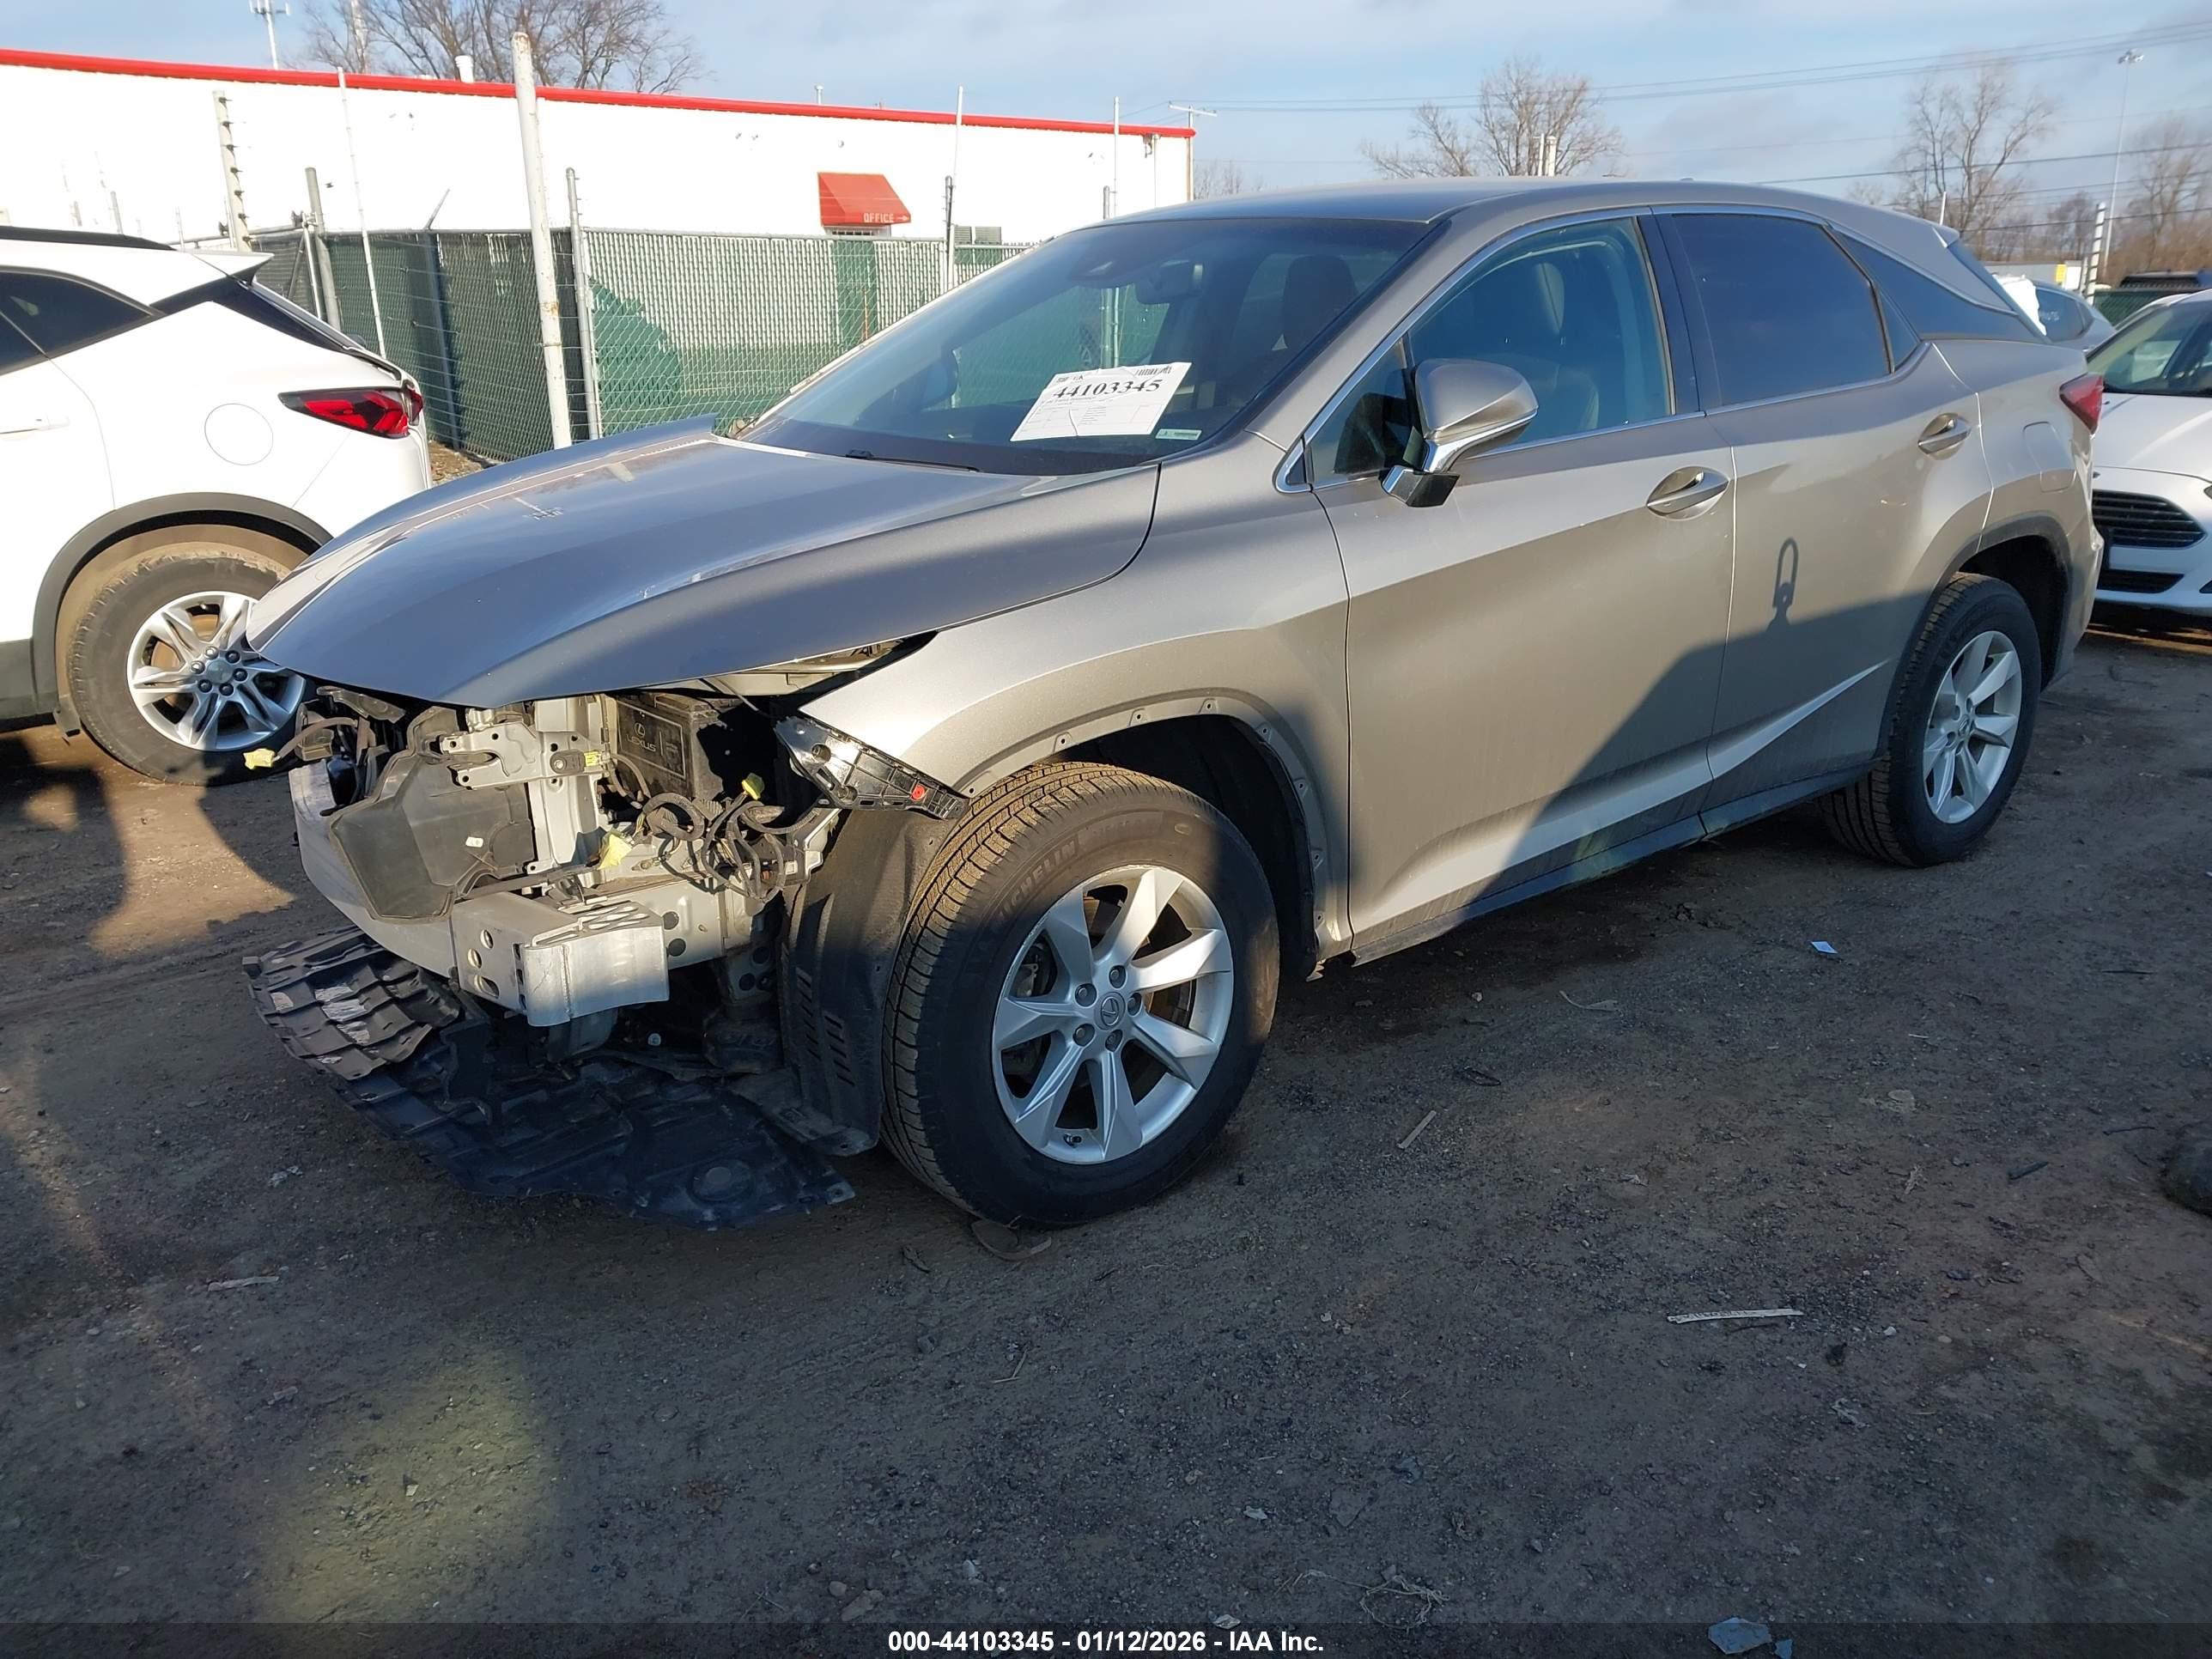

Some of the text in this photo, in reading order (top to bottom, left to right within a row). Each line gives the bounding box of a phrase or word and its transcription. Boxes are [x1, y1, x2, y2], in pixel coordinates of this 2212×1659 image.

[863, 212, 895, 223] OFFICE
[1053, 379, 1164, 398] 44103345
[626, 734, 657, 752] LEXUS
